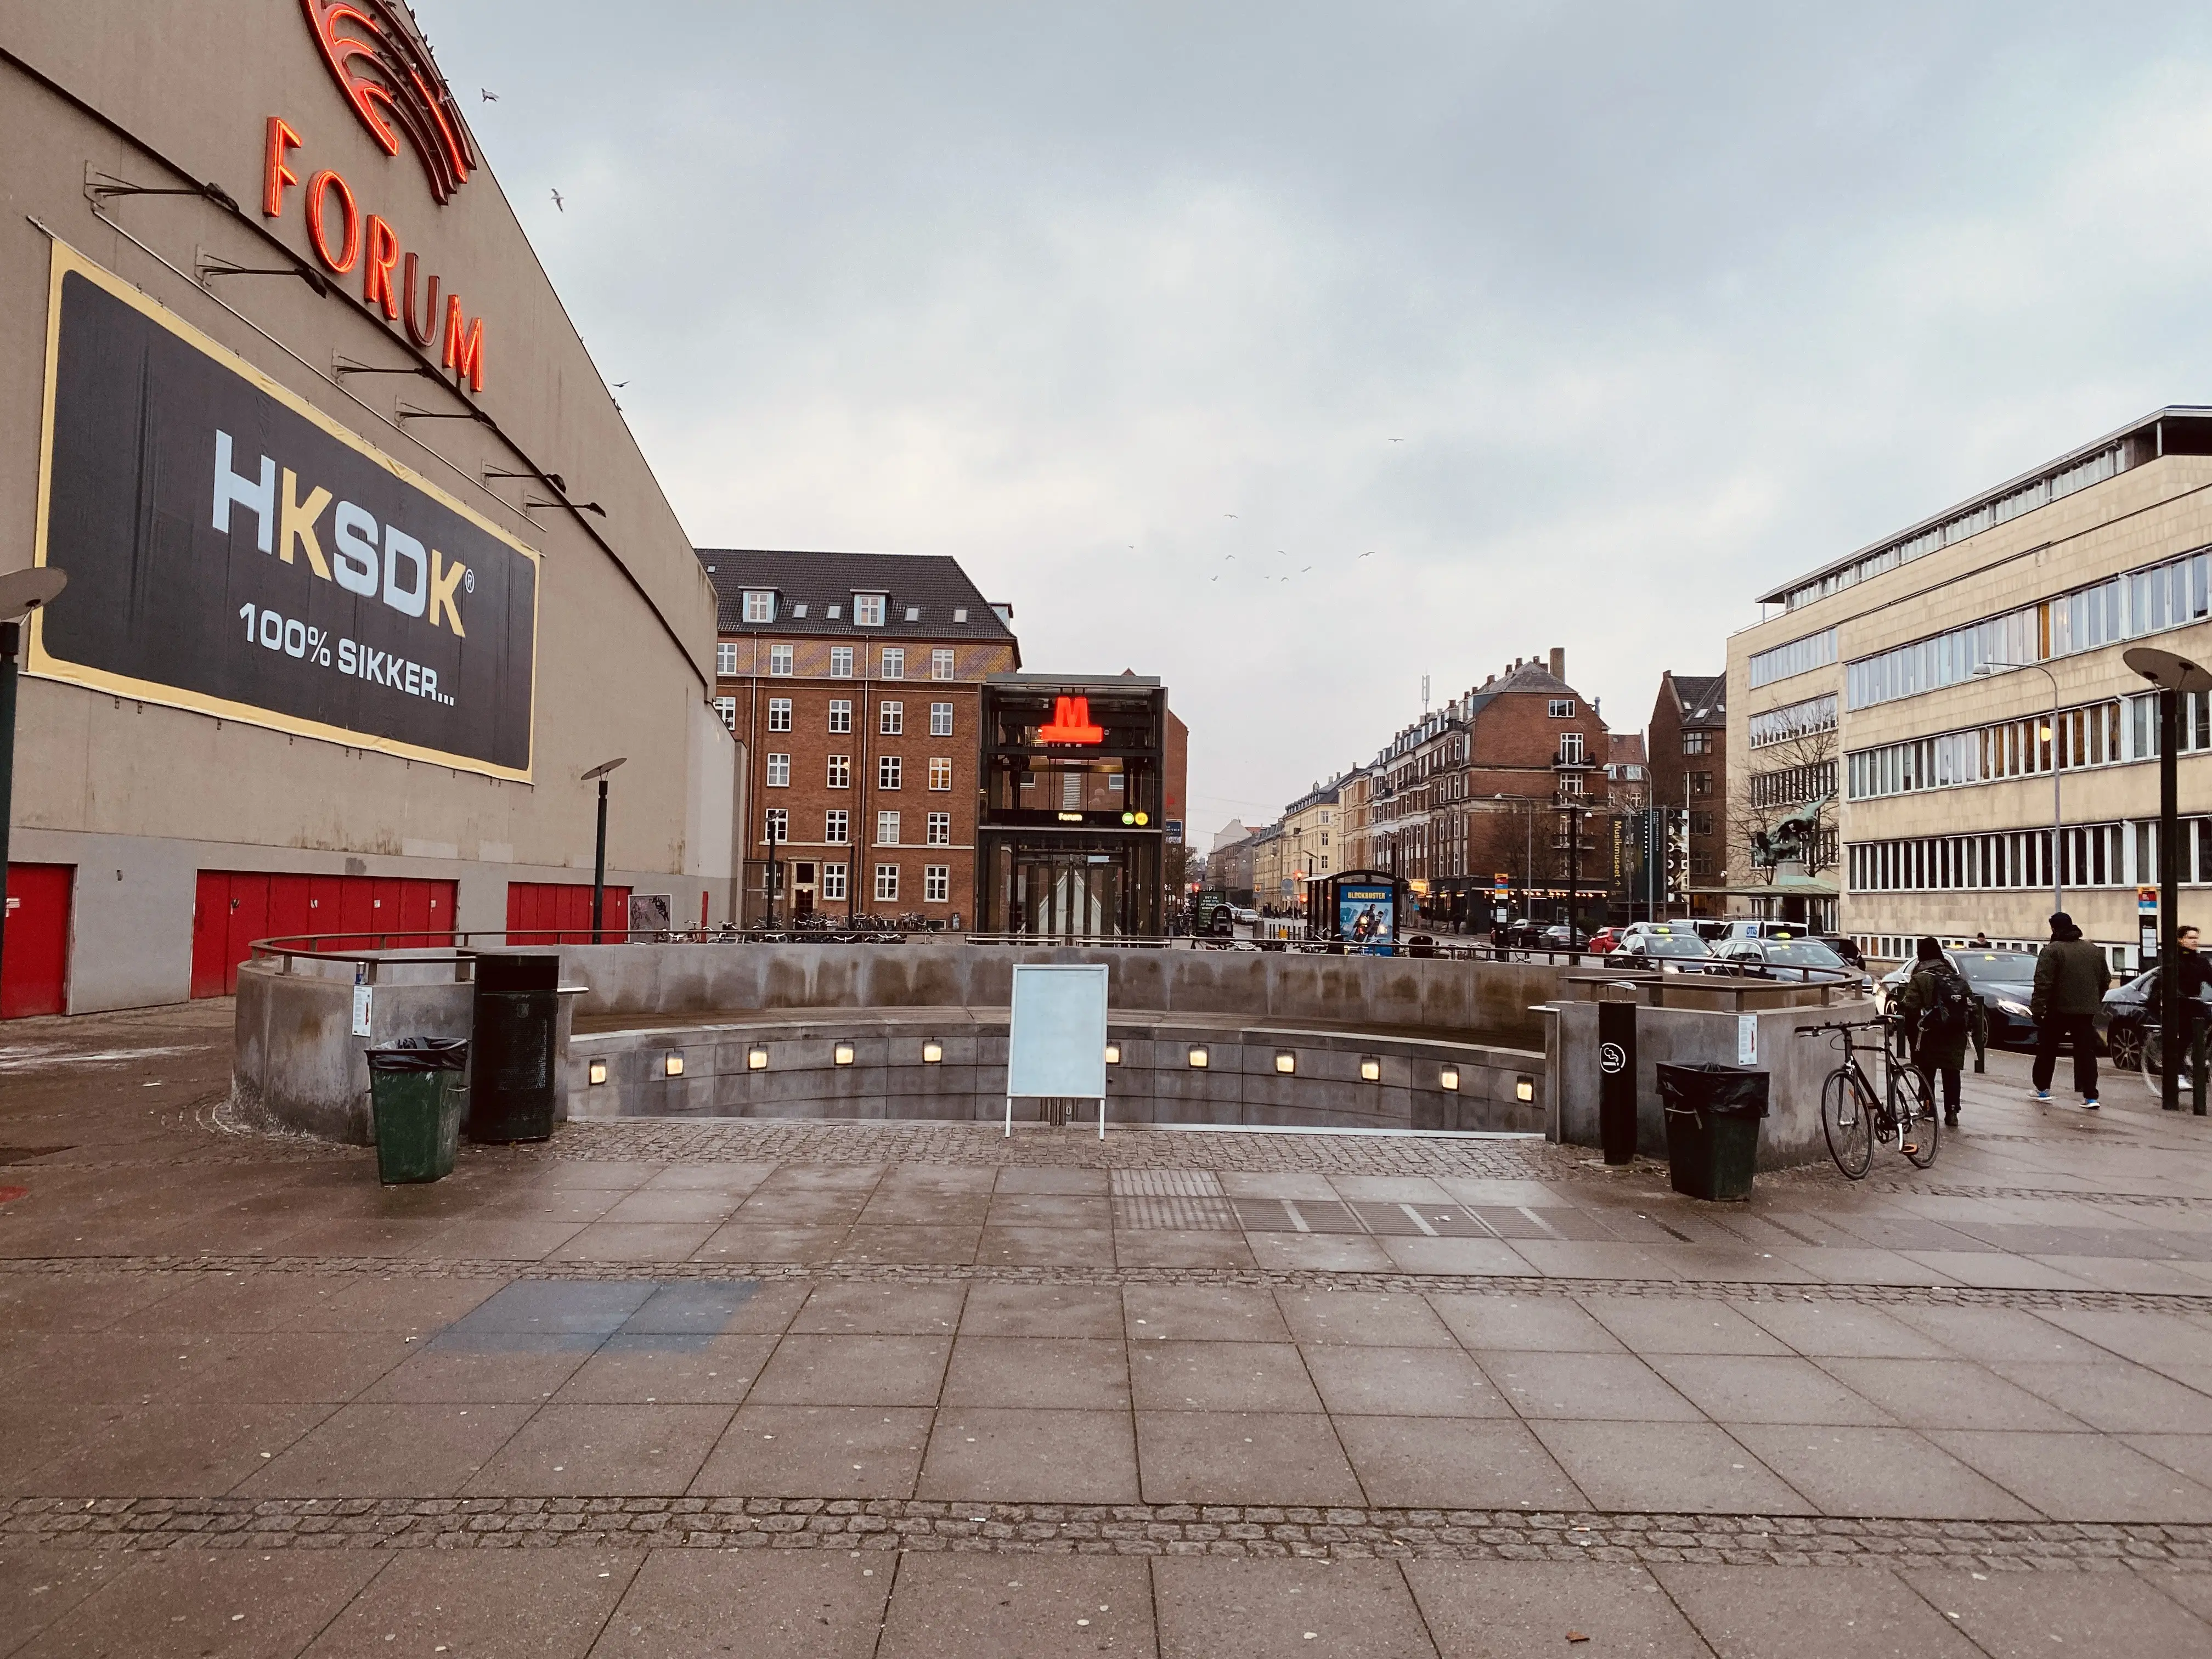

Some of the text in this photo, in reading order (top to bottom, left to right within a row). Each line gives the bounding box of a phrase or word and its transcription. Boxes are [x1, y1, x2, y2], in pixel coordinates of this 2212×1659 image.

[262, 116, 483, 393] FORUM
[239, 602, 455, 708] 100% SIKKER...
[1058, 812, 1083, 821] Forum
[1614, 821, 1623, 878] Musikmuseet
[1746, 926, 1758, 935] OTIS
